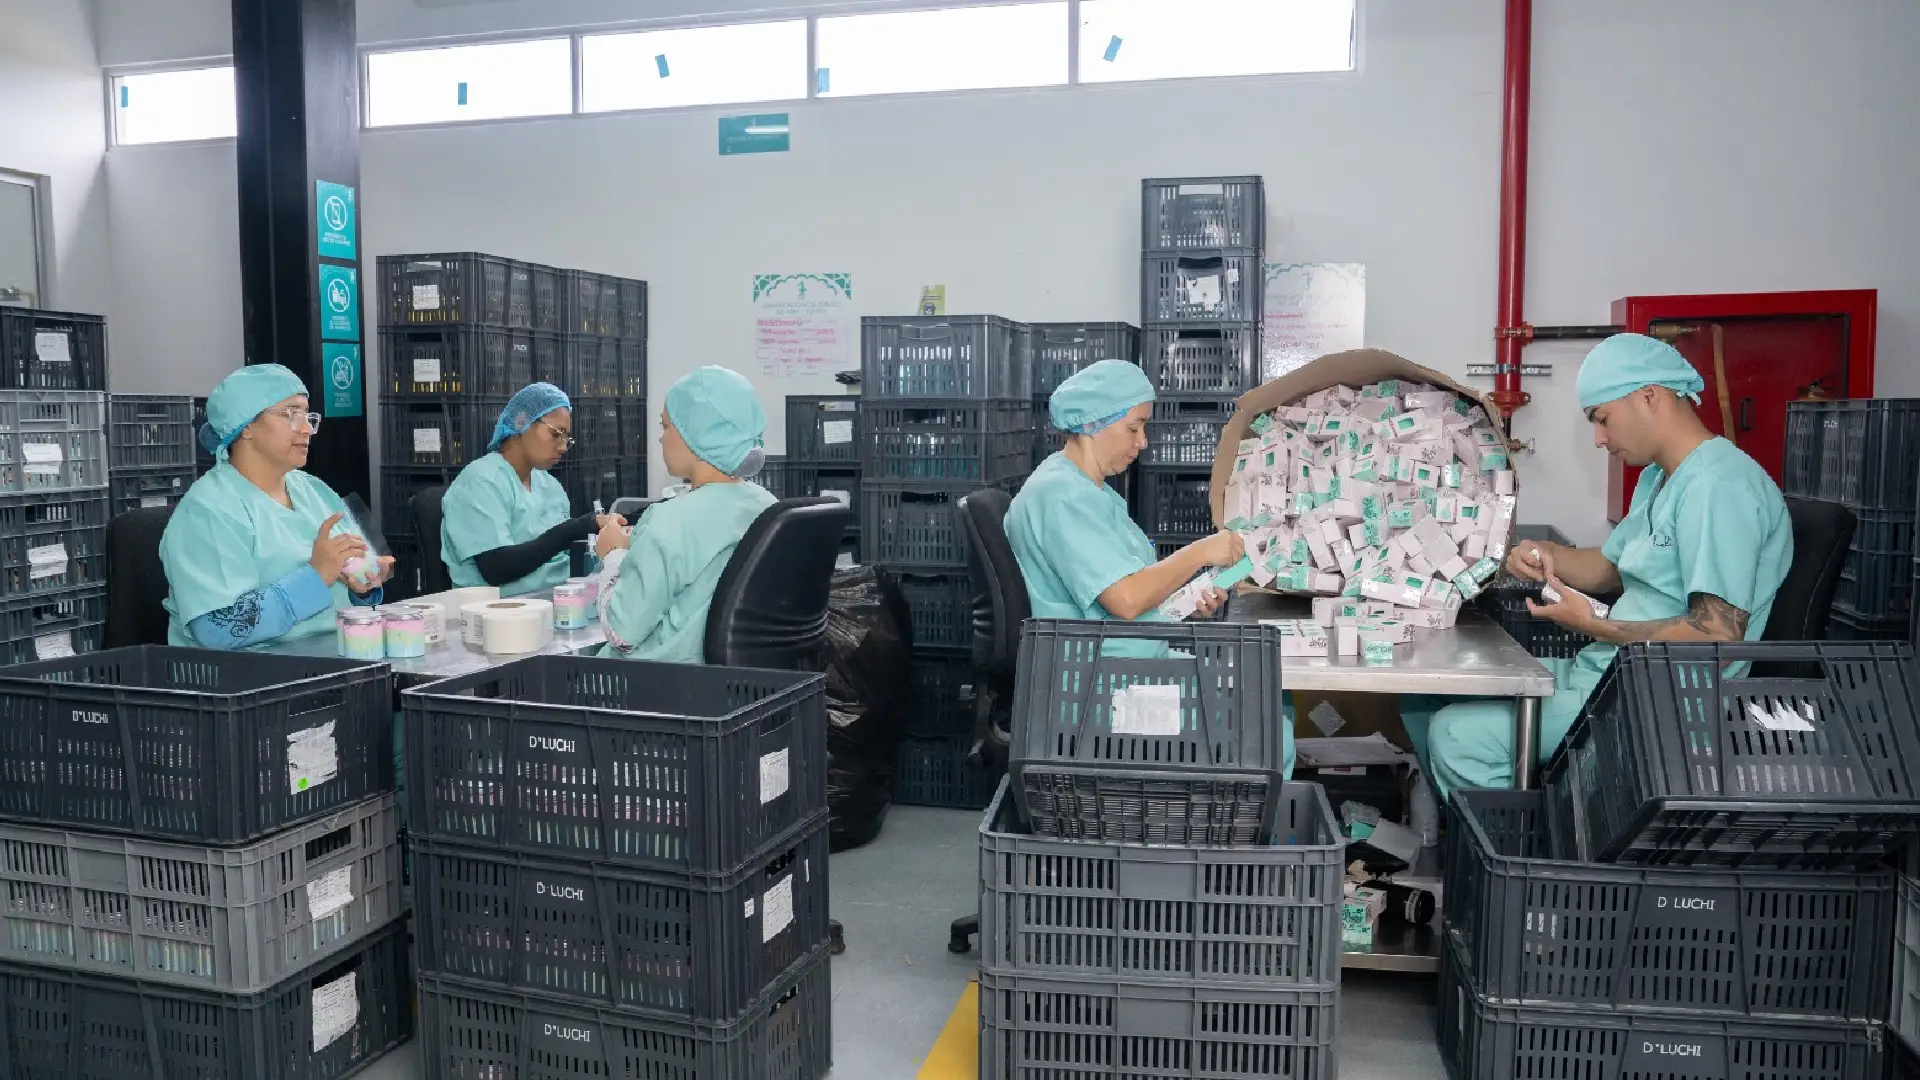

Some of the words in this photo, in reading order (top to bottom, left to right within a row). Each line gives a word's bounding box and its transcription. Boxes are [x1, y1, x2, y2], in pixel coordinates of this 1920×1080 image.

[529, 735, 576, 753] D'LUCHI
[544, 1023, 591, 1043] D'LUCHI
[1643, 1041, 1702, 1057] D'LUCHI
